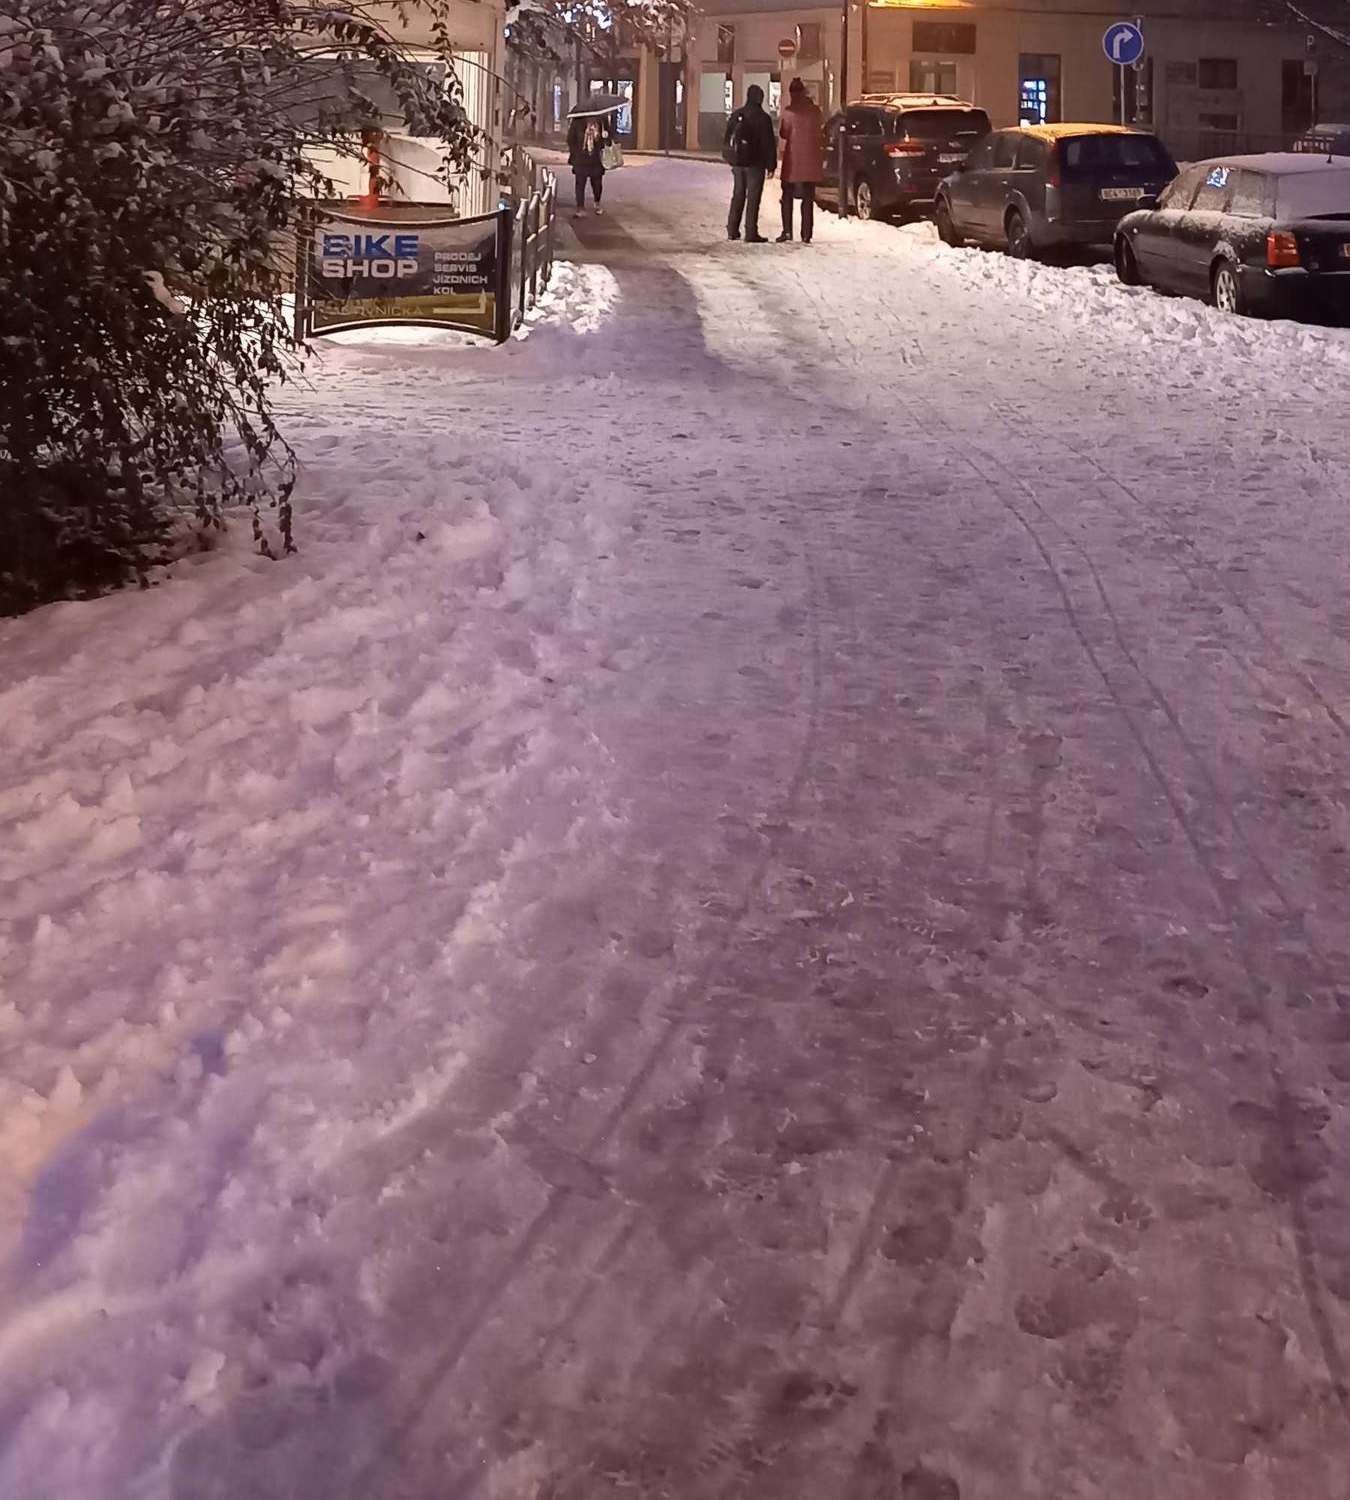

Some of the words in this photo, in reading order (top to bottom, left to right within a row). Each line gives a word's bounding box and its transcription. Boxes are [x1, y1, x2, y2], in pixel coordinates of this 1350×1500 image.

[322, 234, 419, 258] BIKE
[434, 252, 482, 262] PRODEJ
[322, 259, 419, 278] SHOP
[433, 263, 477, 273] SERVIS
[433, 286, 457, 296] KOL
